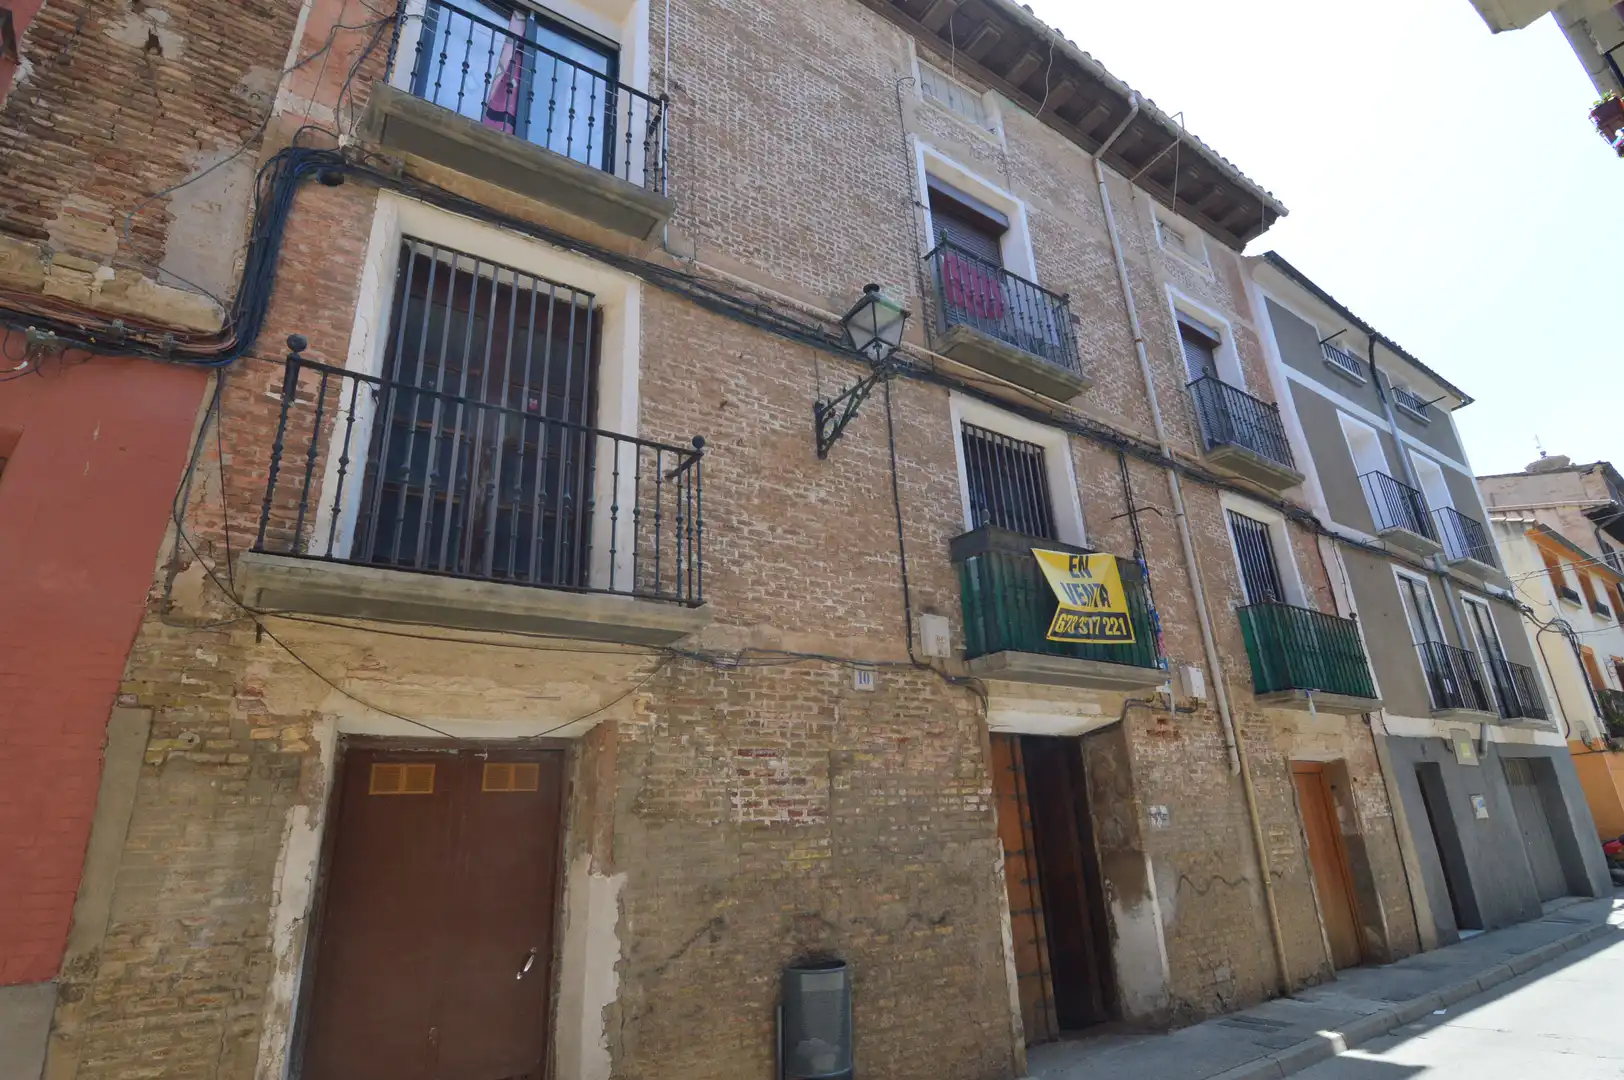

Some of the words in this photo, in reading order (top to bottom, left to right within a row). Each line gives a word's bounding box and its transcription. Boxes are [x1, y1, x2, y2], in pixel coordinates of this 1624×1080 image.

[1069, 555, 1092, 578] EN
[1060, 583, 1112, 608] VENTA
[1103, 617, 1127, 635] 221
[858, 671, 870, 685] 10
